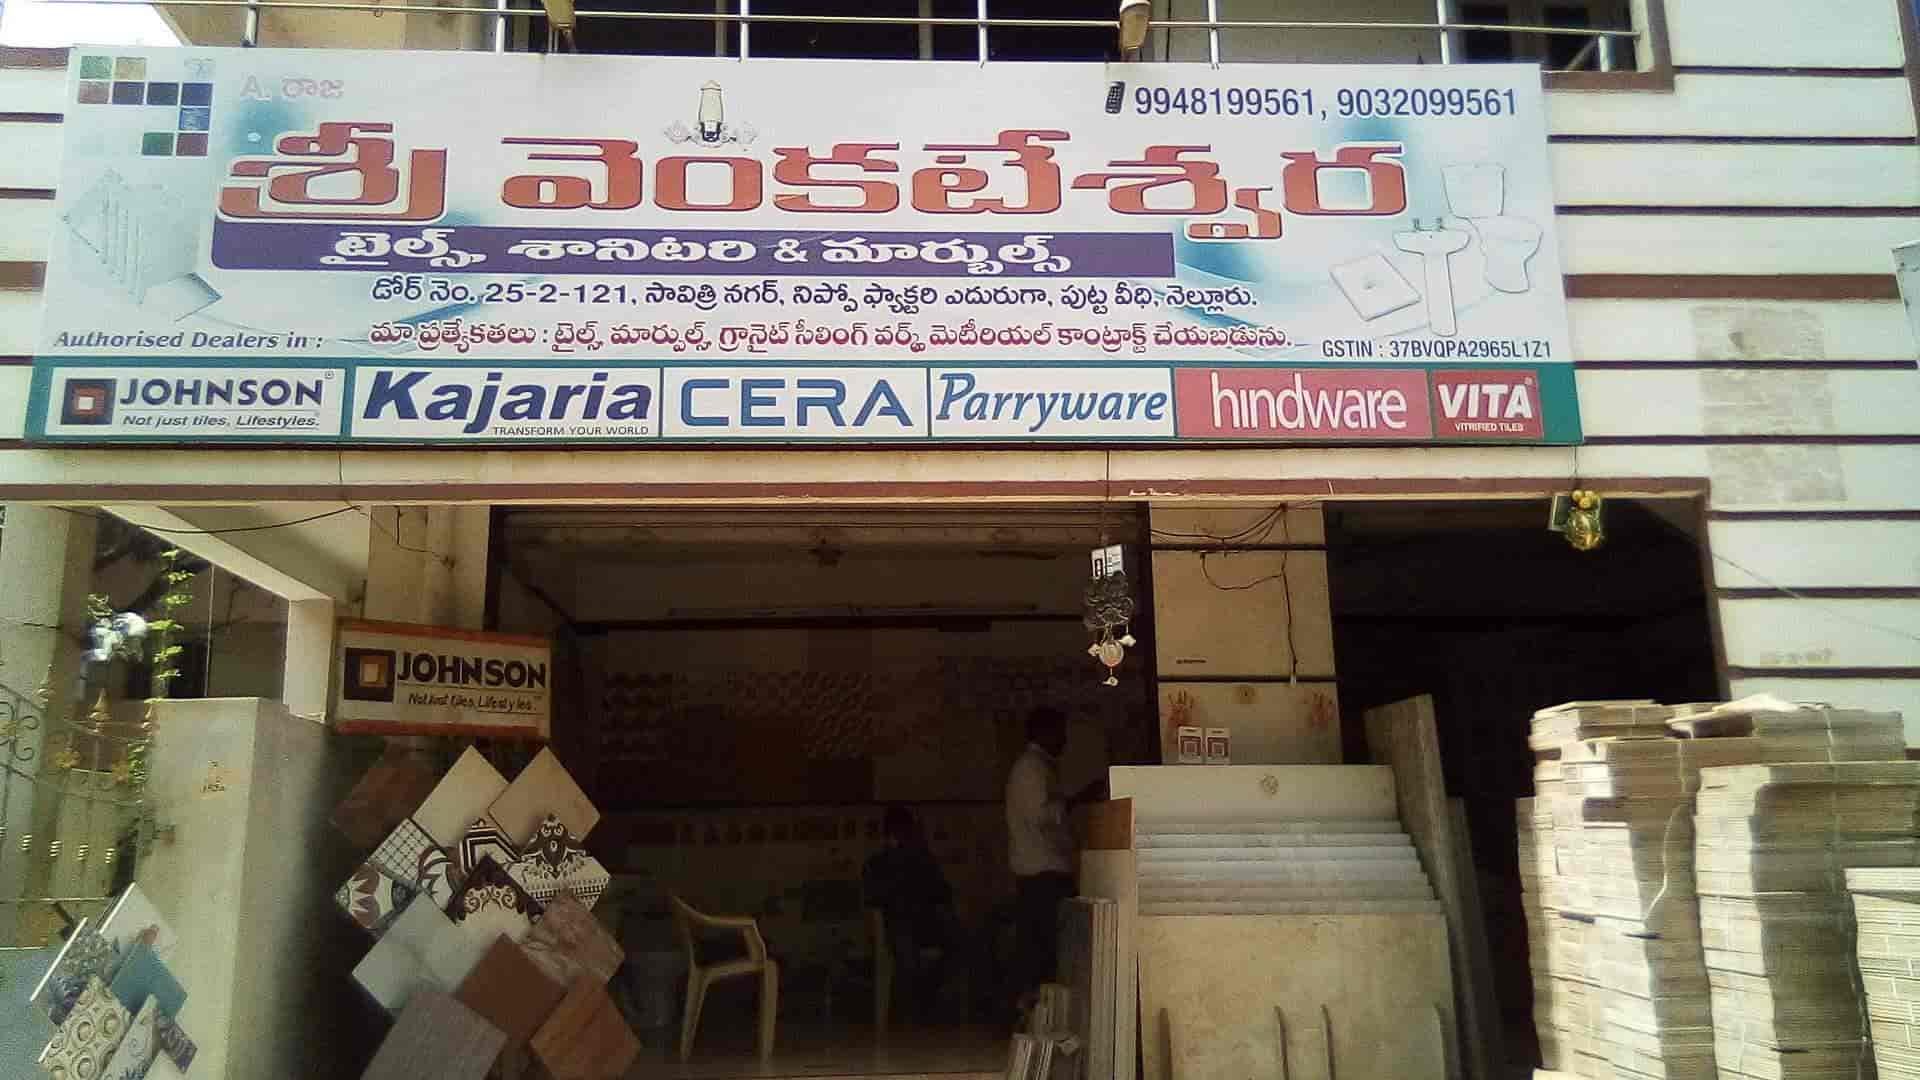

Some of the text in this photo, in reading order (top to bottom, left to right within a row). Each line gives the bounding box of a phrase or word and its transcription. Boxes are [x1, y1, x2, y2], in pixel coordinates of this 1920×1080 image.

[1135, 87, 1517, 119] 9948199561, 9032099561
[219, 122, 1407, 240] శ్రీ వెంకటేశ్వర
[507, 236, 757, 263] శానిటరి
[773, 238, 808, 263] &
[372, 275, 422, 301] డోర్
[482, 283, 637, 306] 25-2-121,
[645, 281, 717, 310] సావిత్రి
[724, 280, 784, 306] నగర్,
[792, 282, 858, 312] నిప్పో
[863, 282, 938, 314] ఫ్యాక్టరి
[945, 286, 1054, 307] ఎదురుగా,
[1060, 284, 1108, 315] పుట్ట
[1114, 281, 1159, 308] వీధి,
[54, 330, 184, 349] Authorised
[191, 331, 280, 349] Dealers
[286, 331, 308, 349] in
[370, 321, 413, 343] మా
[718, 321, 790, 353] గ్రానైట్
[795, 318, 869, 346] సీలింగ్
[929, 318, 1053, 346] మెటీరియల్
[1322, 340, 1373, 358] GSTIN
[1388, 340, 1551, 359] 37BVQPA2965L1Z1
[119, 378, 324, 406] JOHNSON
[362, 370, 653, 434] Kajaria
[680, 378, 915, 427] CERA
[935, 372, 1168, 432] Parryware
[1211, 370, 1408, 429] hindware
[1437, 383, 1534, 419] VITA
[122, 414, 153, 426] Not
[154, 414, 188, 429] just
[235, 414, 321, 429] Lifestyles.
[493, 425, 649, 436] TRANSFORM YOUR WORLD
[1454, 422, 1524, 432] VITRIFIED TILES
[397, 651, 546, 689] JOHNSON
